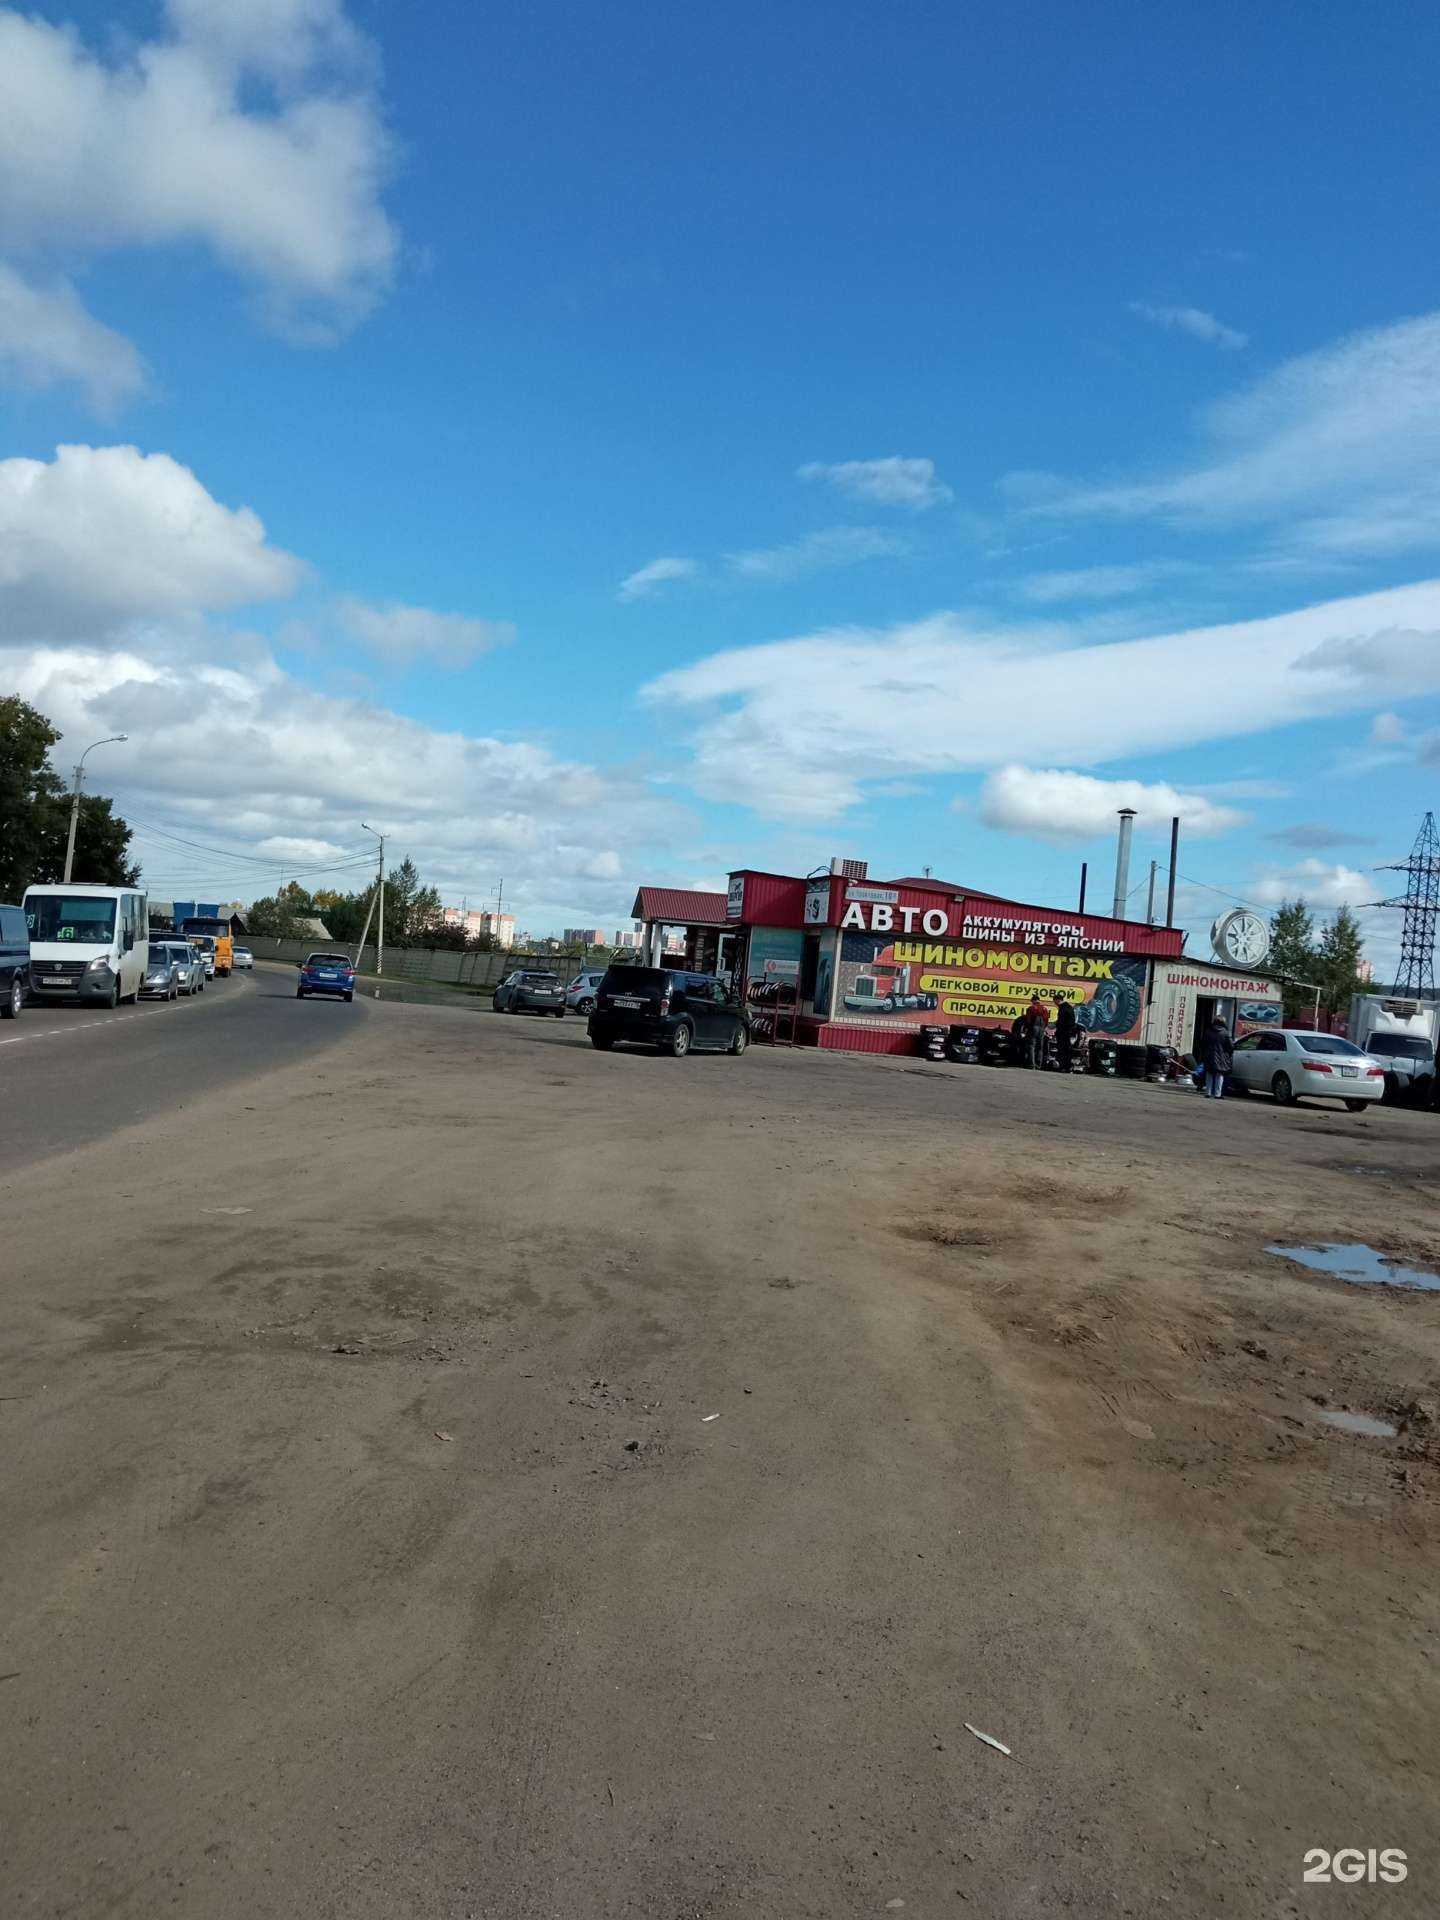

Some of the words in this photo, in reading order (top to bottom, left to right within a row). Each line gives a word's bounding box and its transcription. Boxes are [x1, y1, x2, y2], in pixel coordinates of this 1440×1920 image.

[841, 902, 949, 936] АВТО
[963, 915, 1084, 937] АККУМУЛЯТОРЫ
[962, 926, 1015, 943] ШИНЫ
[1024, 933, 1046, 946] ИЗ
[930, 978, 999, 994] ЛЕГКОВОЙ
[1008, 985, 1076, 1000] ГРУЗОВОЙ
[1167, 973, 1270, 994] ШИНОМОНТАЖ
[950, 1001, 1017, 1017] ПРОДАЖА
